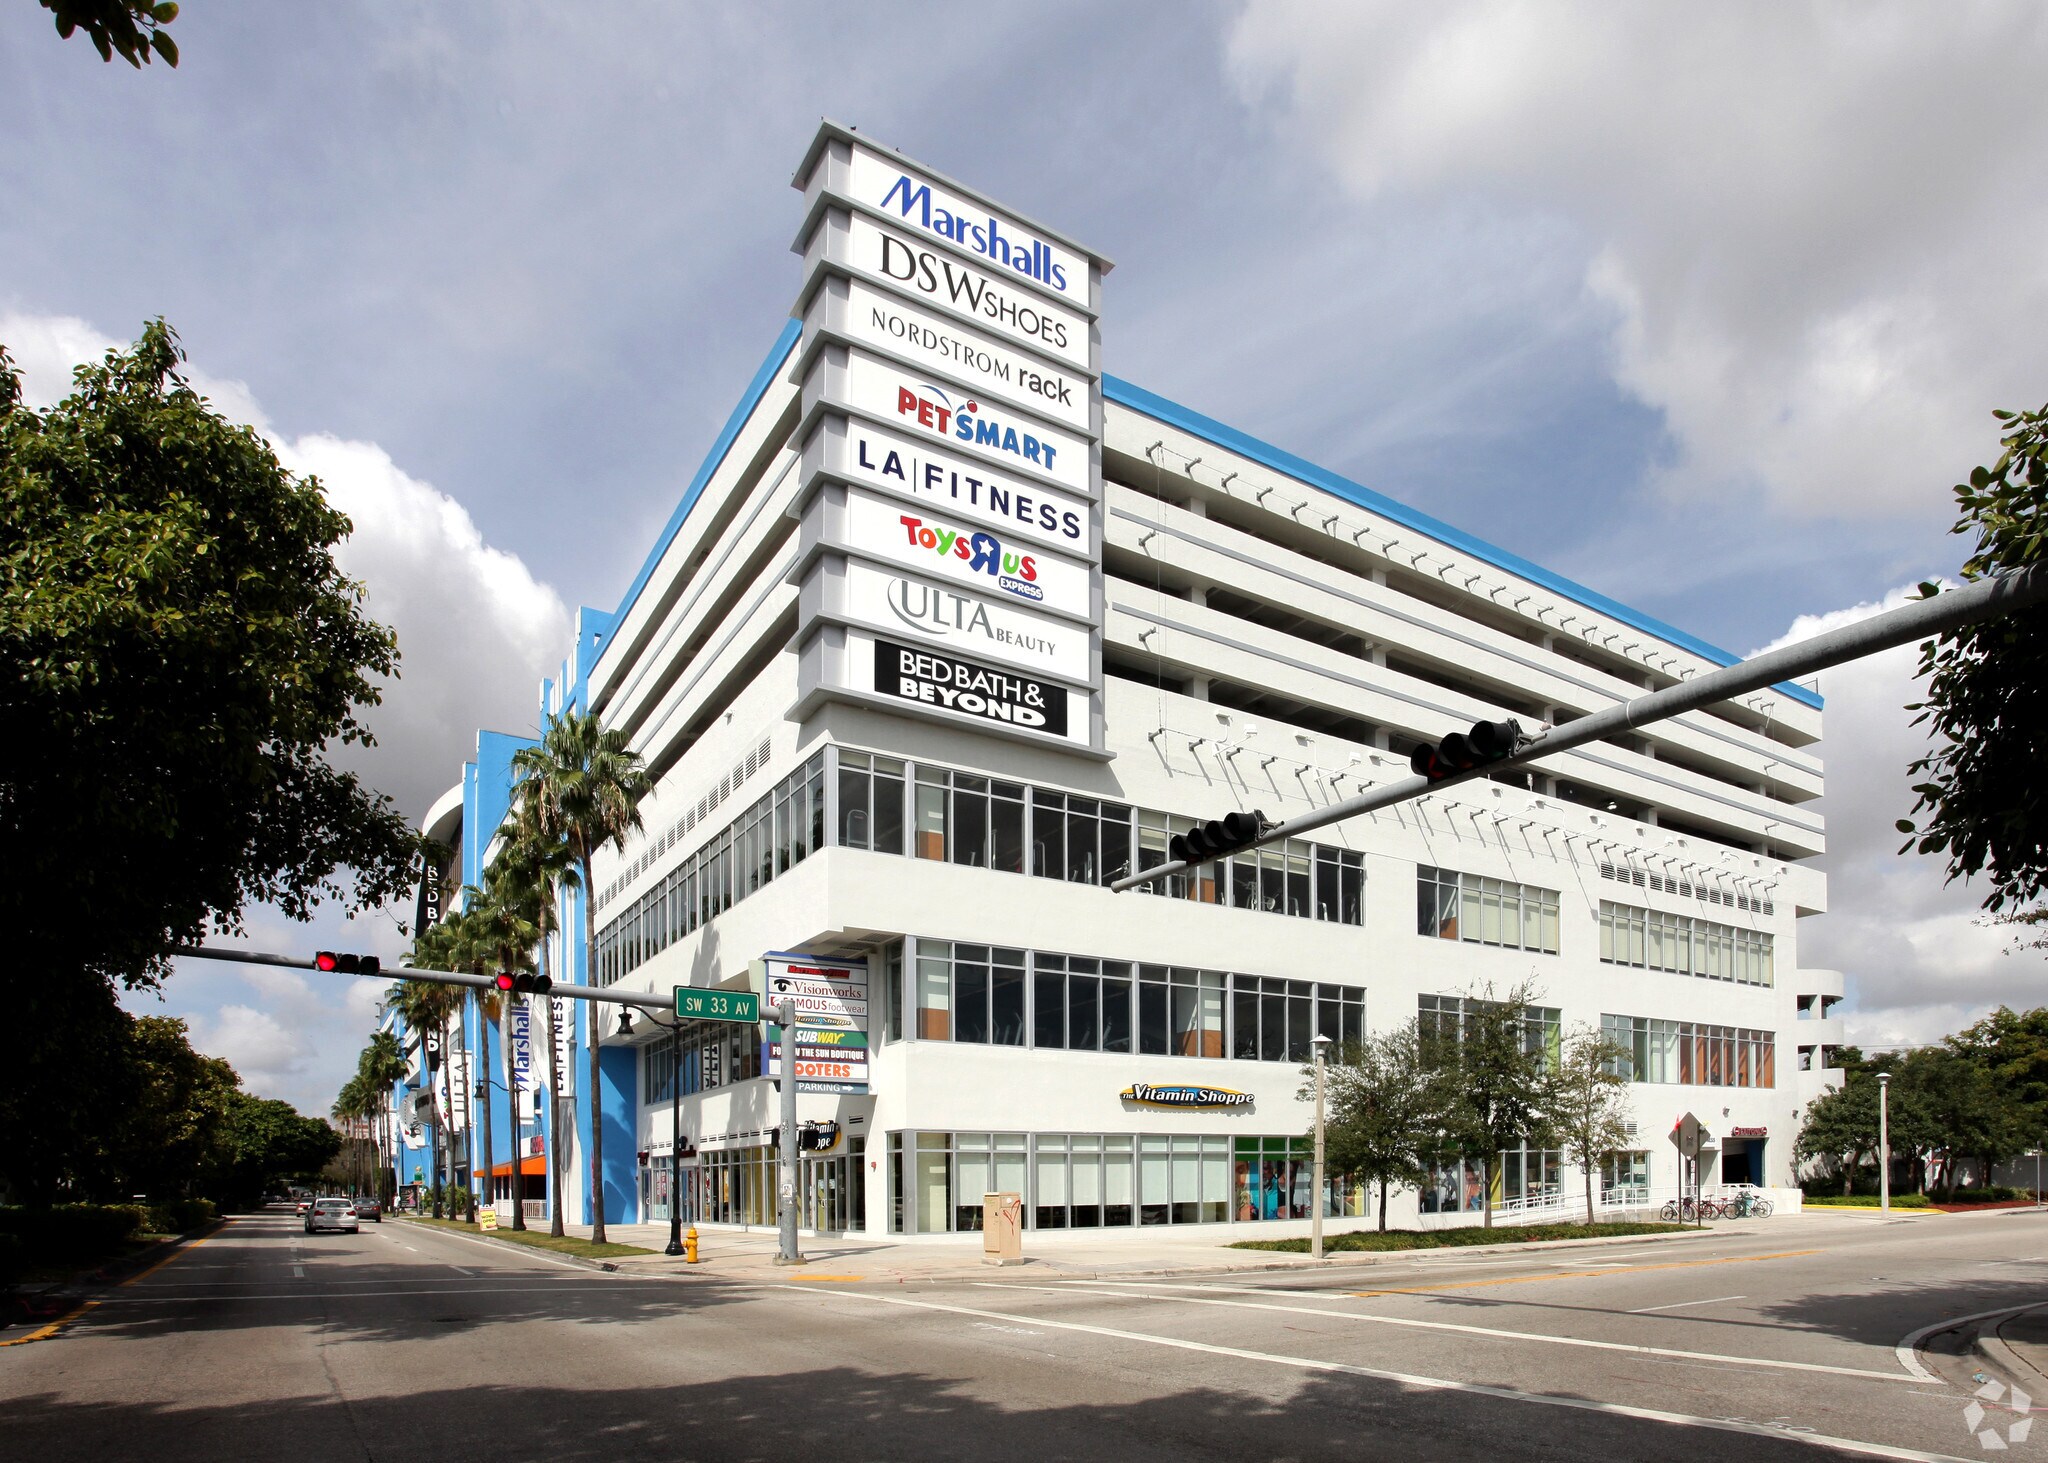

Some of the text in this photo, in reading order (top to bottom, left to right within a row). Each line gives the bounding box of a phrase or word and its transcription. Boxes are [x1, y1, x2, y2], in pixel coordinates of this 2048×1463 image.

[879, 175, 1067, 292] Marshalls
[879, 232, 1068, 348] DSW SHOES
[872, 307, 1072, 407] NORDSTROM rack
[859, 440, 1081, 539] LA FITNESS
[899, 579, 1056, 656] ULTA BEAUTY
[900, 649, 1046, 709] BED BATH &
[900, 681, 1047, 727] BEYOND
[794, 981, 862, 998] Visionworks
[686, 997, 749, 1016] SW 33 AV
[828, 1003, 865, 1014] footwear
[795, 1030, 845, 1044] SUBWAY
[801, 1048, 814, 1058] THE
[815, 1049, 830, 1059] SUN
[830, 1049, 864, 1061] BOUTIQUE
[795, 1063, 850, 1077] OOTERS
[798, 1082, 841, 1092] PARKING
[1134, 1085, 1194, 1101] Vitamin
[1197, 1089, 1254, 1104] Shoppe
